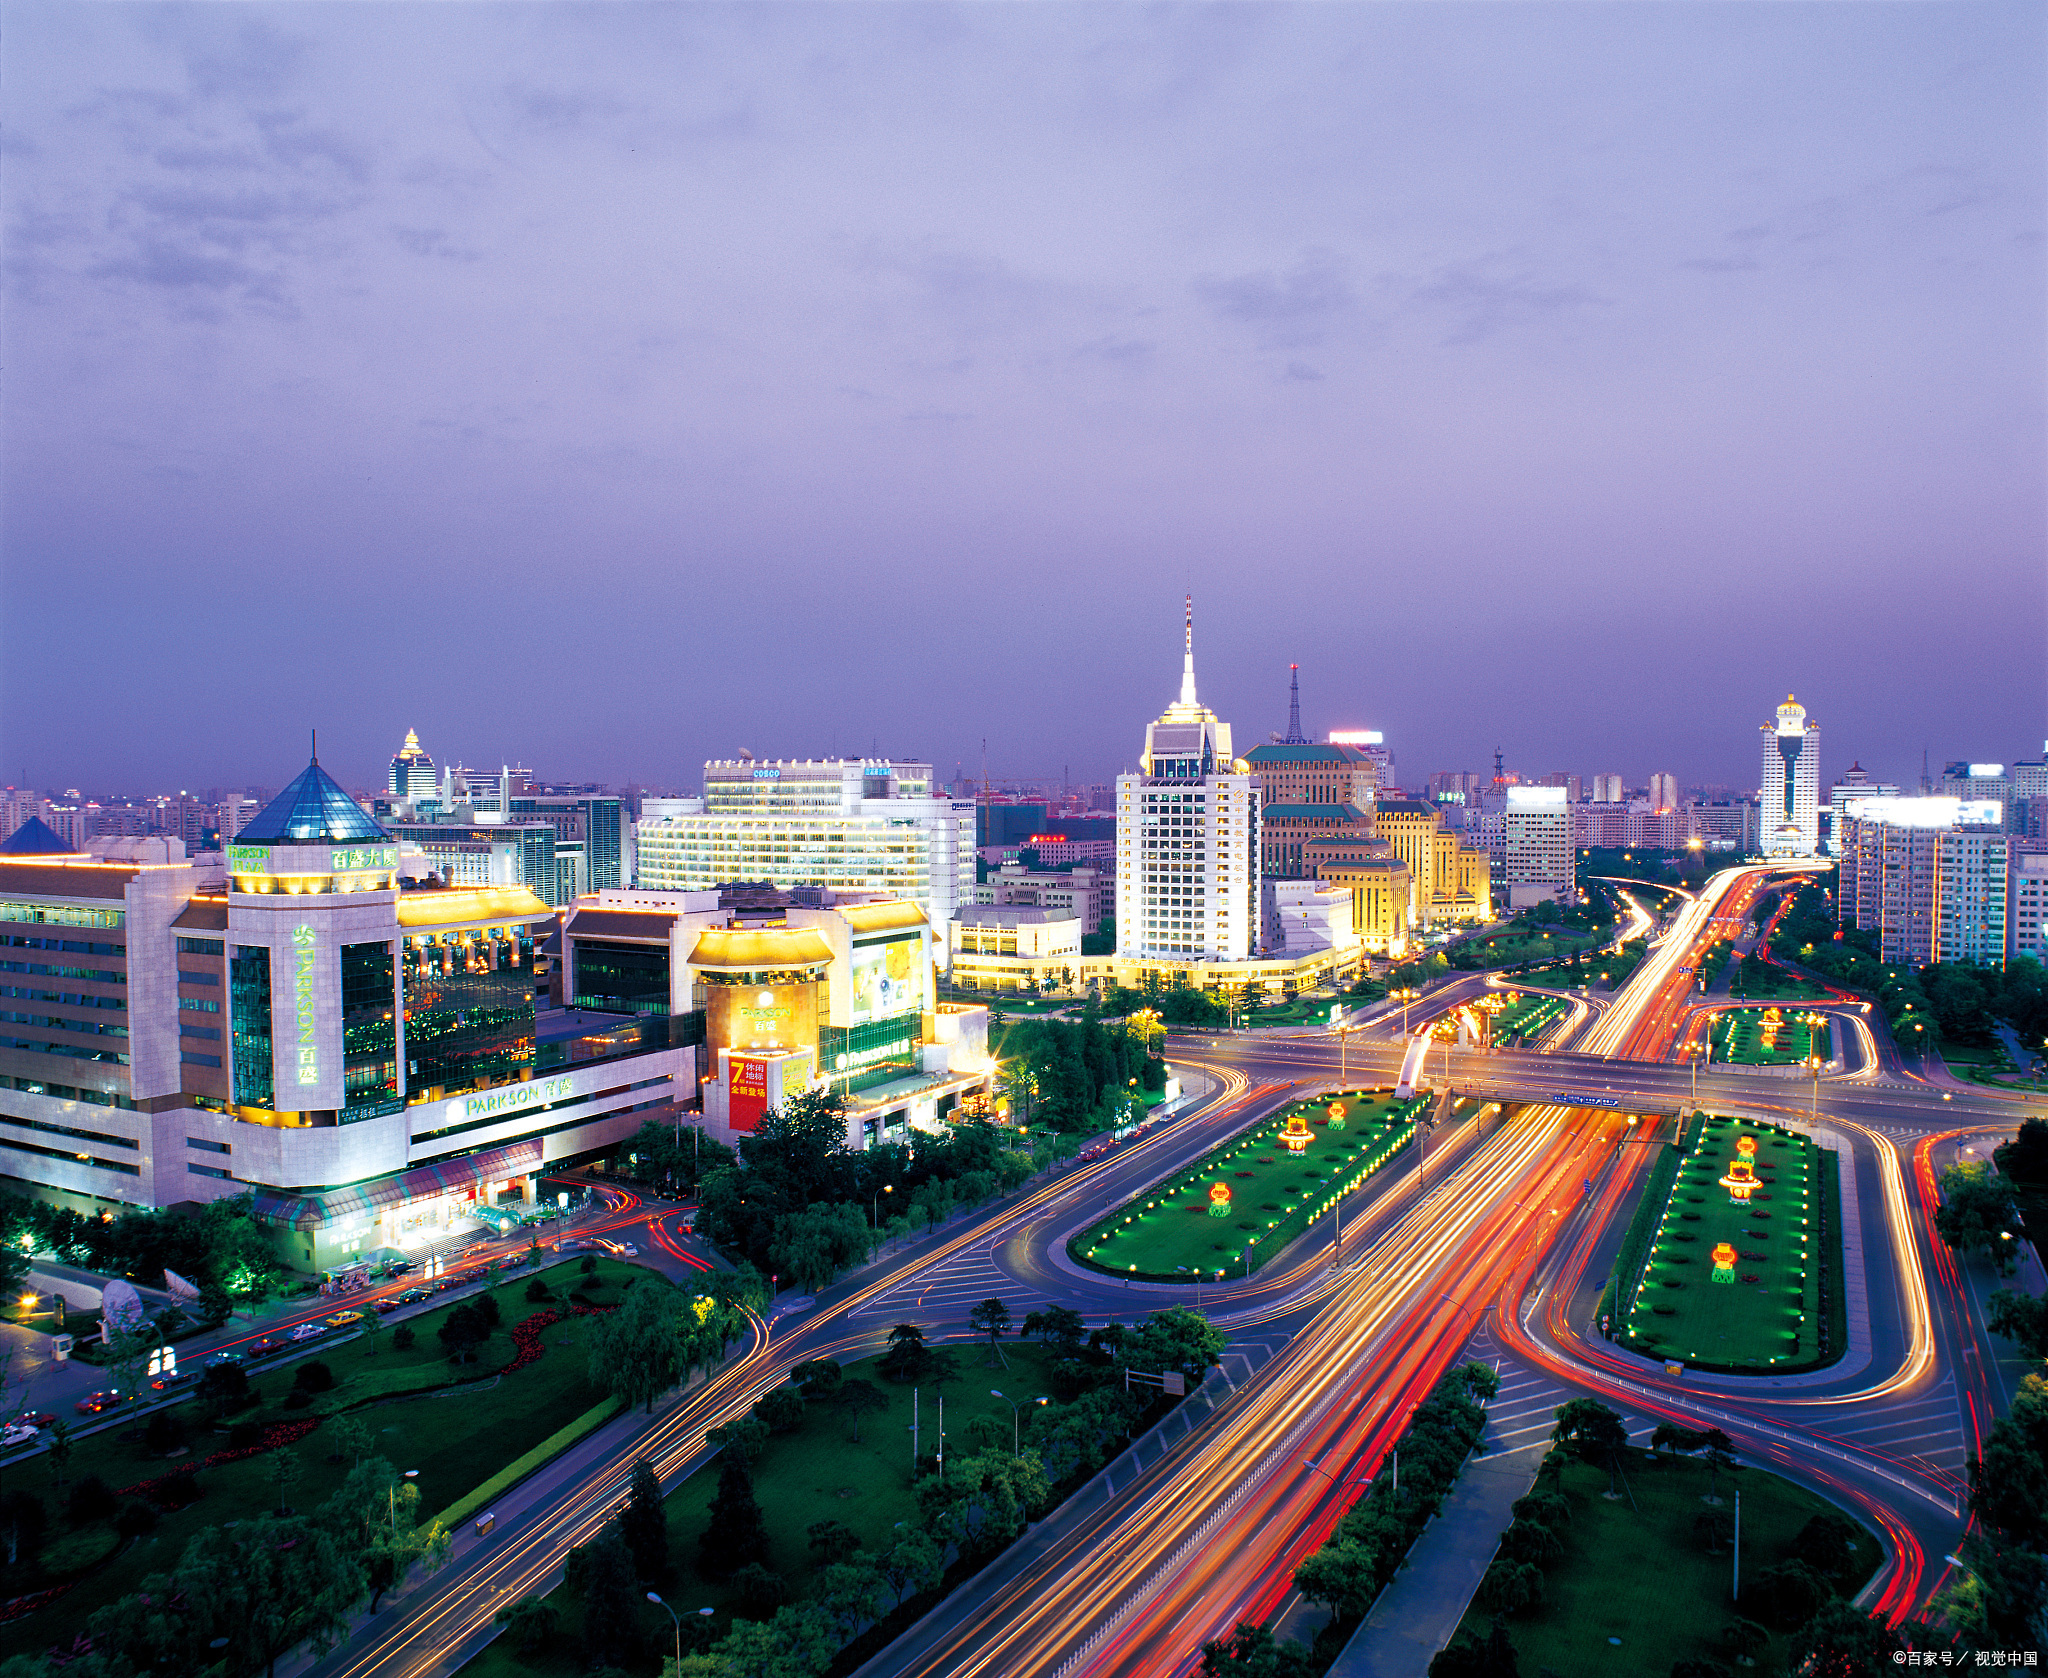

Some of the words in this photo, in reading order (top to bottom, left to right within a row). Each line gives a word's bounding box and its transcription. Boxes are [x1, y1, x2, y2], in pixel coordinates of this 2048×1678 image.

[753, 770, 780, 778] COSCO
[227, 845, 270, 859] PARKSON
[332, 848, 398, 869] 百盛大厦
[233, 860, 266, 873] PLAZA
[296, 949, 315, 1043] PARKSON
[741, 1007, 791, 1018] PARKSON
[755, 1020, 777, 1031] 百盛
[299, 1046, 318, 1084] 百盛
[746, 1062, 764, 1072] 休闲
[746, 1072, 764, 1081] 地标
[467, 1086, 539, 1116] PARKSON
[544, 1077, 573, 1098] 百盛
[731, 1085, 766, 1098] 全新登场
